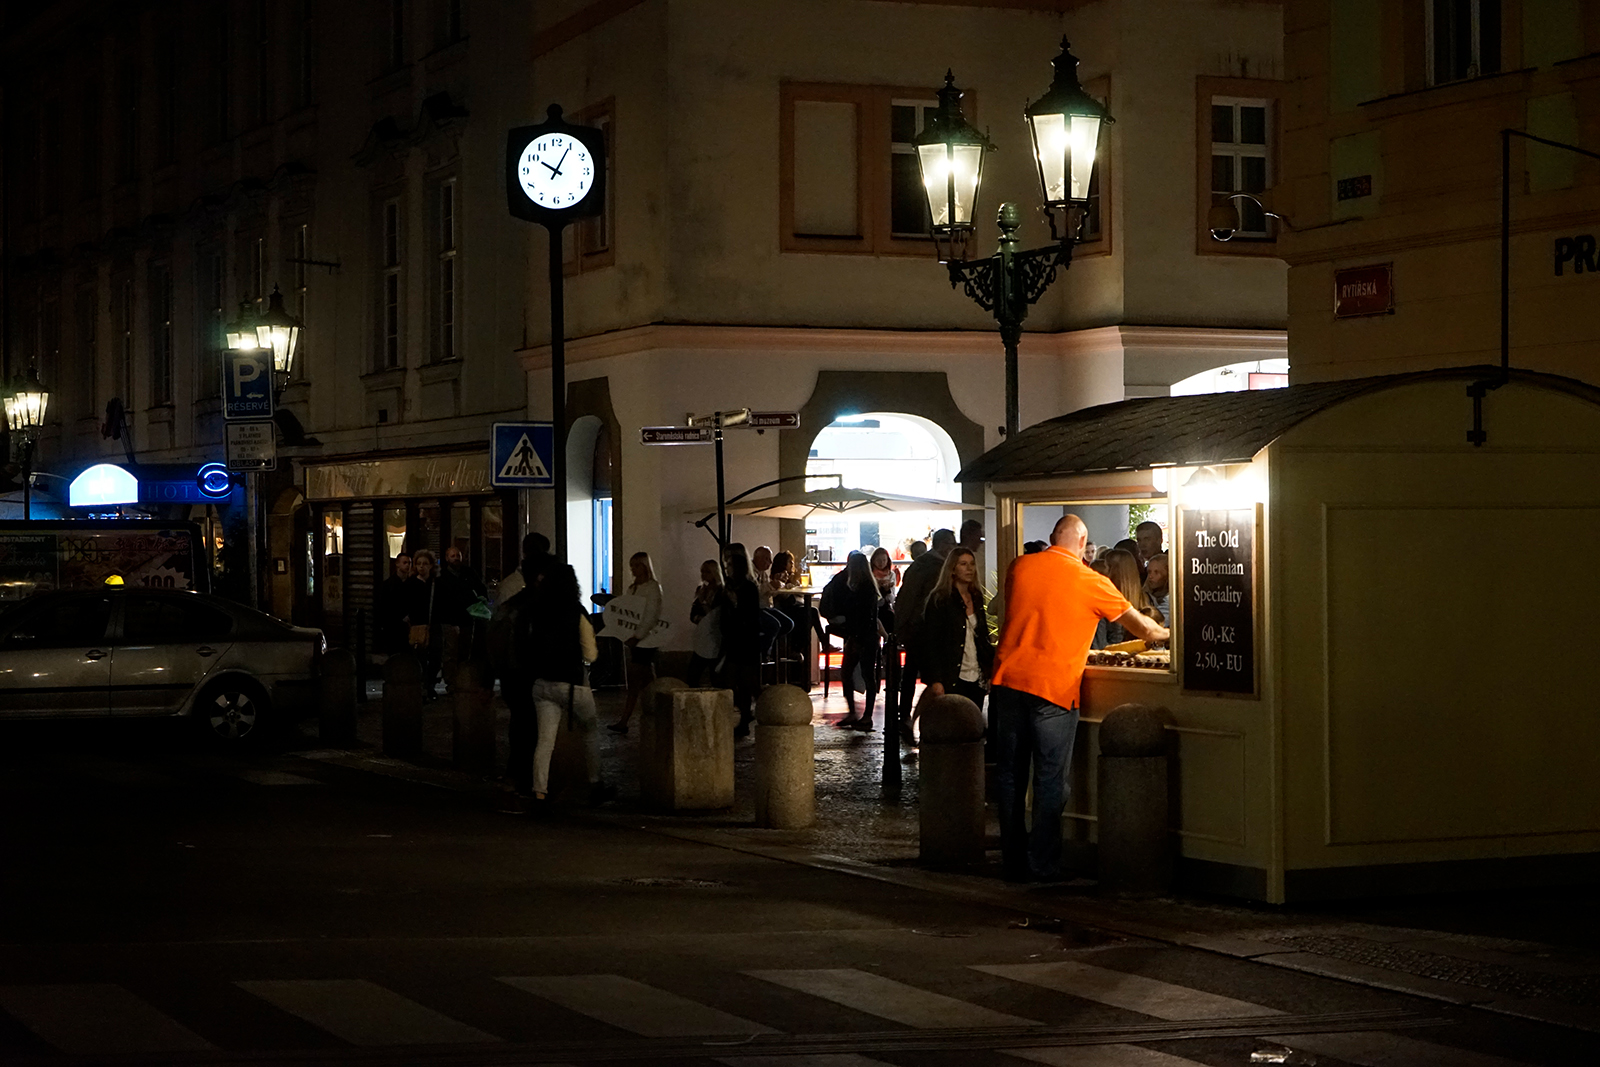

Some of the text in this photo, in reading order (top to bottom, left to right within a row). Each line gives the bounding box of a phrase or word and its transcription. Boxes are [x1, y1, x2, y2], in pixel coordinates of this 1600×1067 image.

[538, 142, 546, 151] 11
[551, 138, 562, 147] 12
[569, 142, 573, 151] 1
[528, 154, 540, 162] 10
[578, 152, 586, 162] 2
[522, 167, 530, 176] 9
[583, 167, 590, 176] 3
[527, 181, 536, 190] 8
[539, 192, 545, 201] 7
[553, 196, 560, 205] 6
[568, 192, 575, 201] 5
[1555, 235, 1600, 277] PR
[1342, 279, 1377, 299] RYTÍŘSKÁ
[228, 400, 270, 412] RÉSERVÉ
[1195, 529, 1240, 549] The Old
[1191, 557, 1244, 576] Bohemian
[1193, 584, 1243, 608] Speciality
[1201, 624, 1236, 645] 60,-Kč
[1195, 651, 1243, 672] 2,50,- EU
